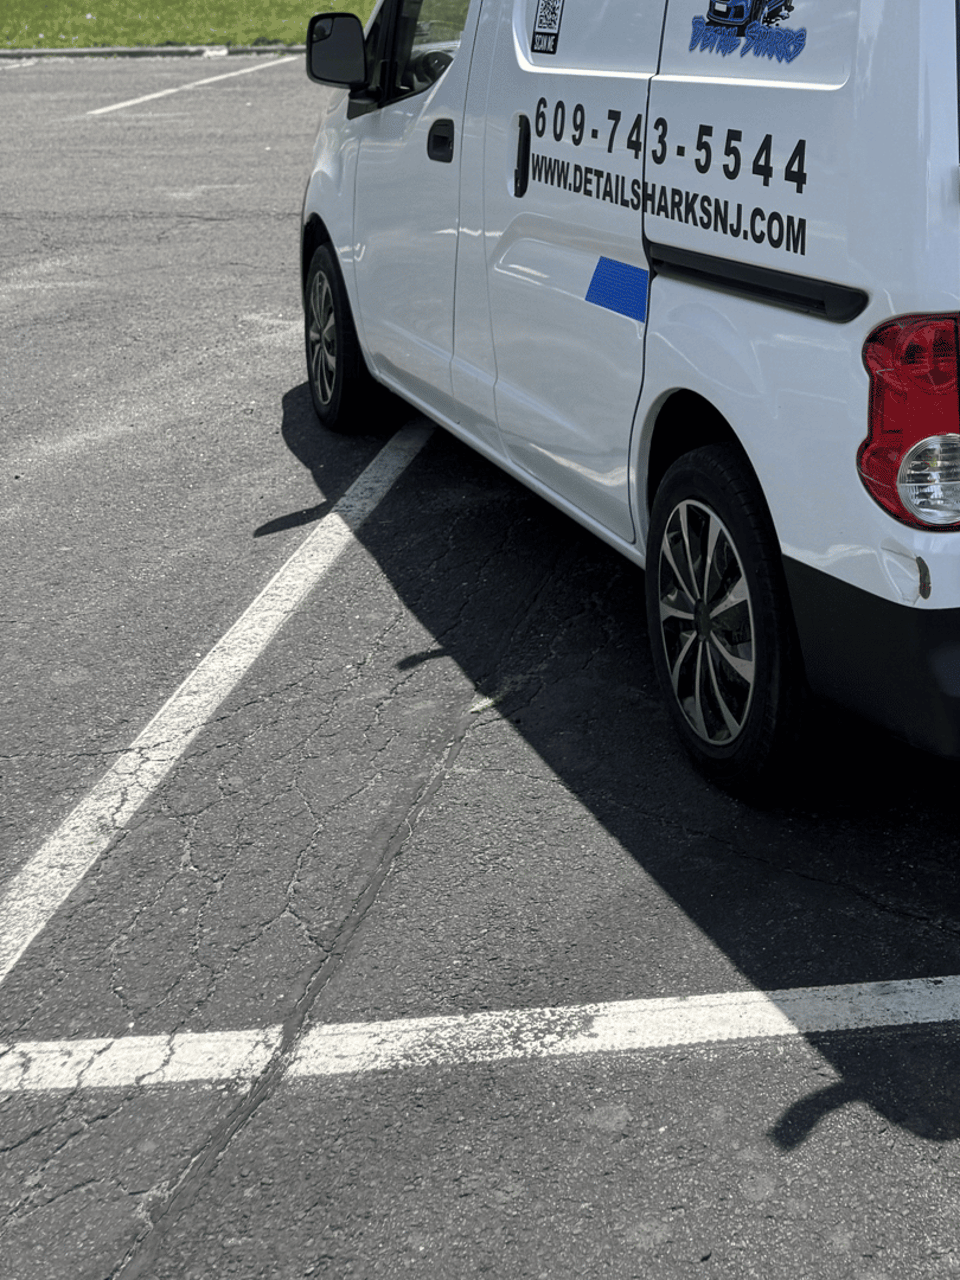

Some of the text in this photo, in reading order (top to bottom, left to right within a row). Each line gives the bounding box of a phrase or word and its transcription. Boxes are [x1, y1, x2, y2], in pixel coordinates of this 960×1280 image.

[534, 34, 549, 51] SCAN
[534, 96, 808, 194] 609-743-5544
[531, 153, 807, 256] WWW.DETAILSHARKSNJ.COM
